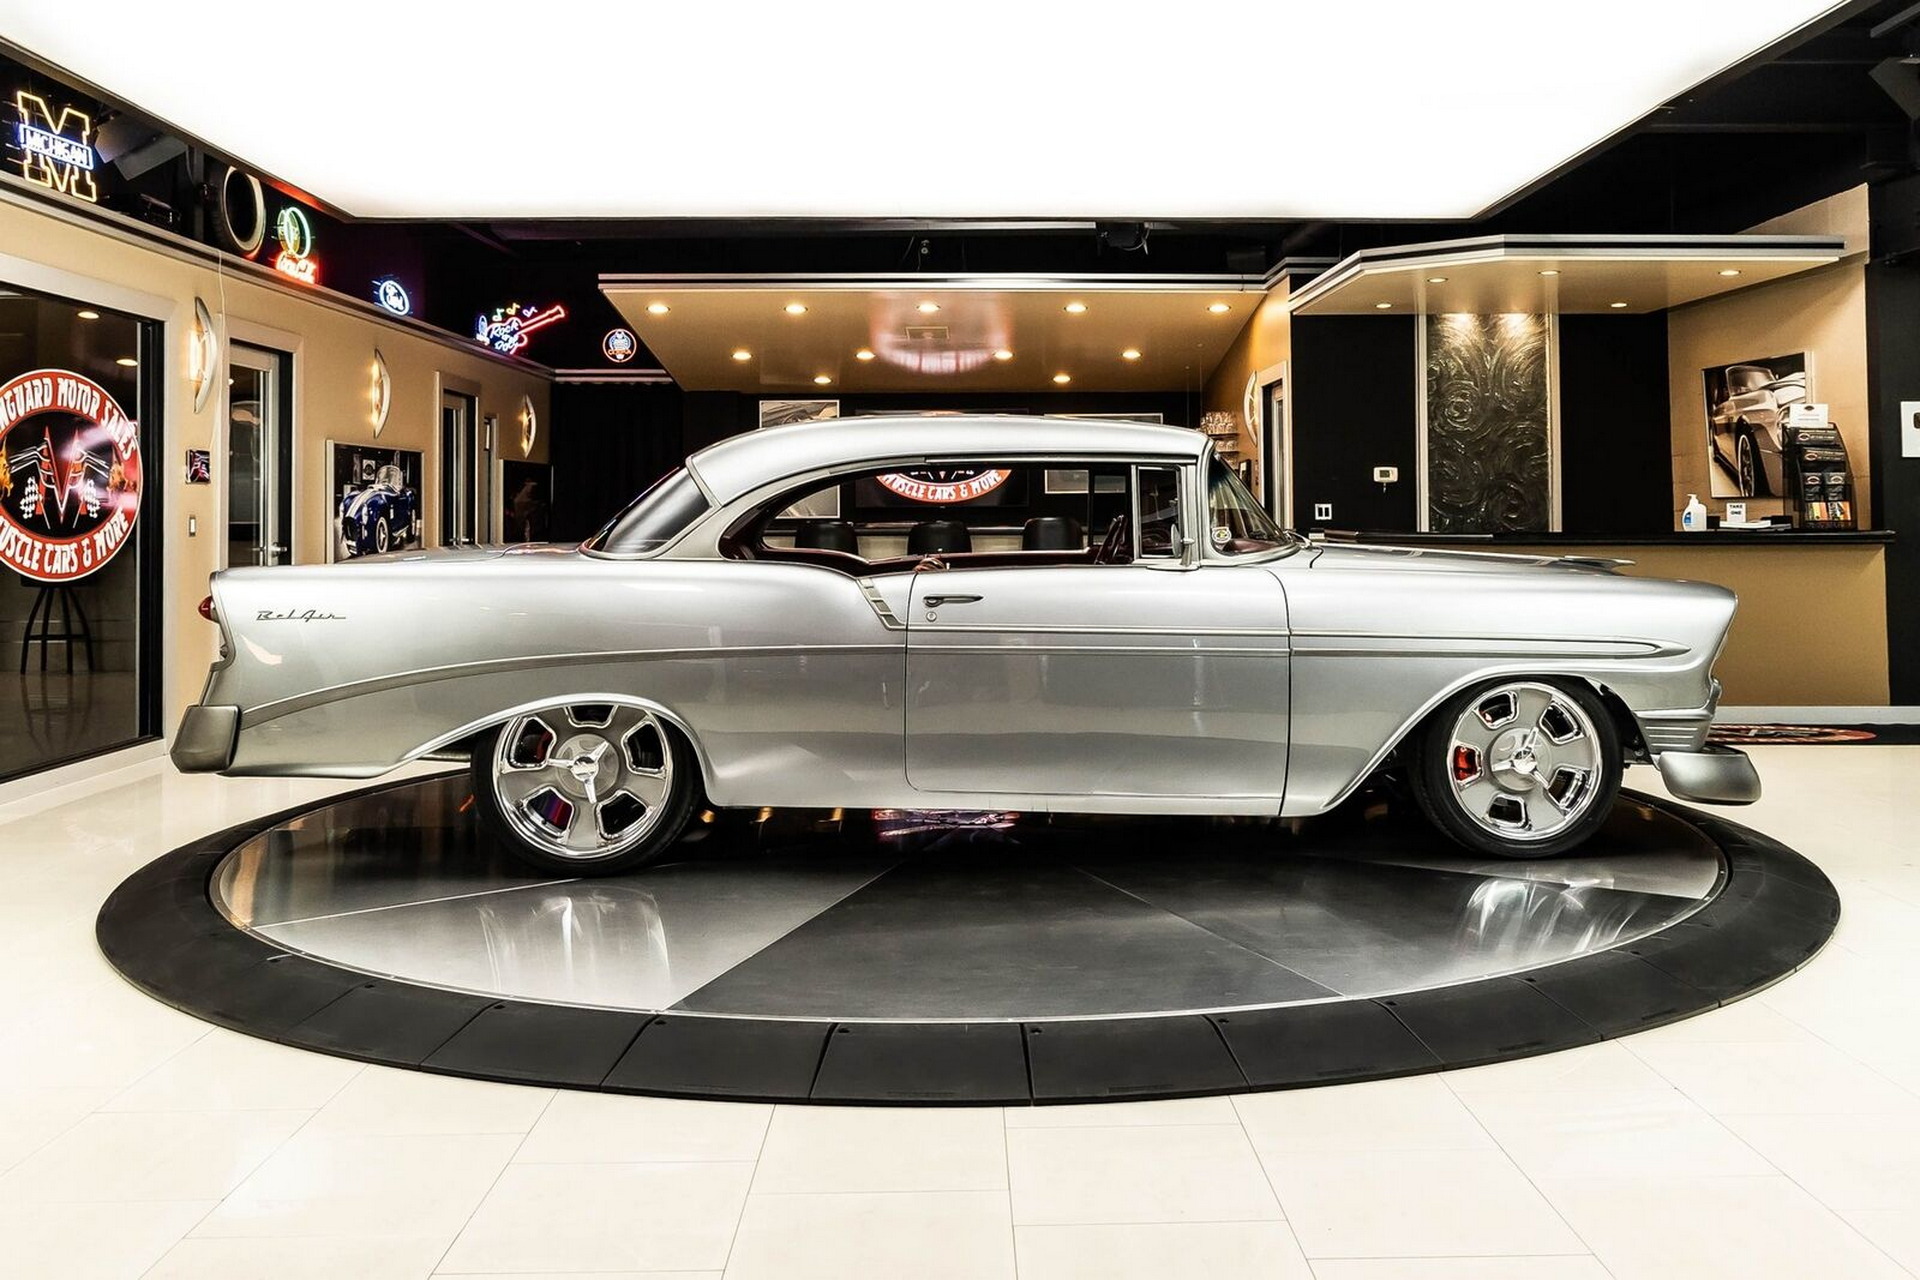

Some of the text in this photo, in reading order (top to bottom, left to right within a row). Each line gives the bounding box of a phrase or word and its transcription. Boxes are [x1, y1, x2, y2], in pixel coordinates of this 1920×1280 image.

[26, 129, 87, 165] MICHIGAN
[57, 377, 101, 421] MOTOR
[101, 400, 136, 460] SALES
[882, 474, 926, 499] MUSCLE
[927, 485, 956, 500] CARS
[959, 484, 968, 498] &
[44, 543, 78, 574] CARS
[82, 537, 92, 568] &
[94, 511, 130, 560] MORE
